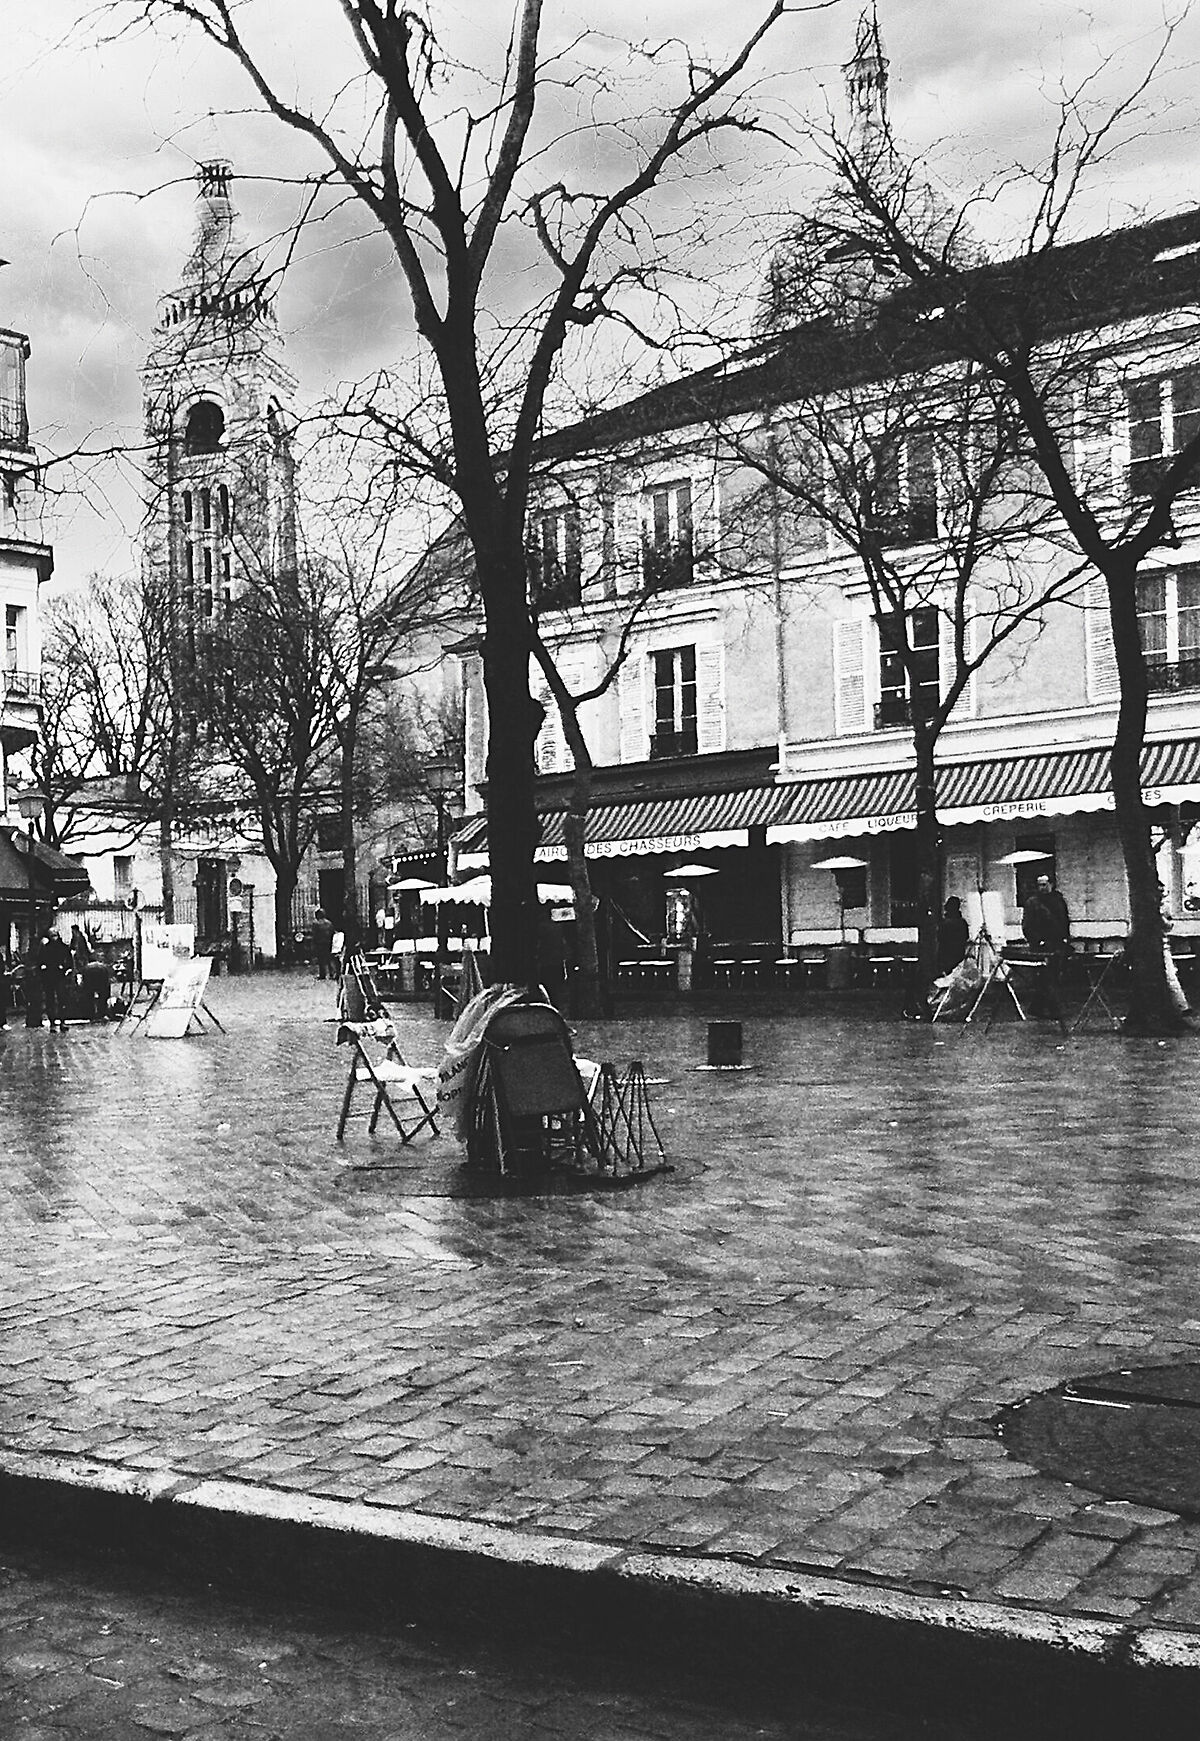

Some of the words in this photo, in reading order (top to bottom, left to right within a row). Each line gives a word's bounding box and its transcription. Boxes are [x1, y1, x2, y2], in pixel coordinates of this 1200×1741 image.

[867, 813, 918, 829] LIQUEUR
[586, 842, 612, 855] DES
[620, 834, 702, 853] CHASSEURS
